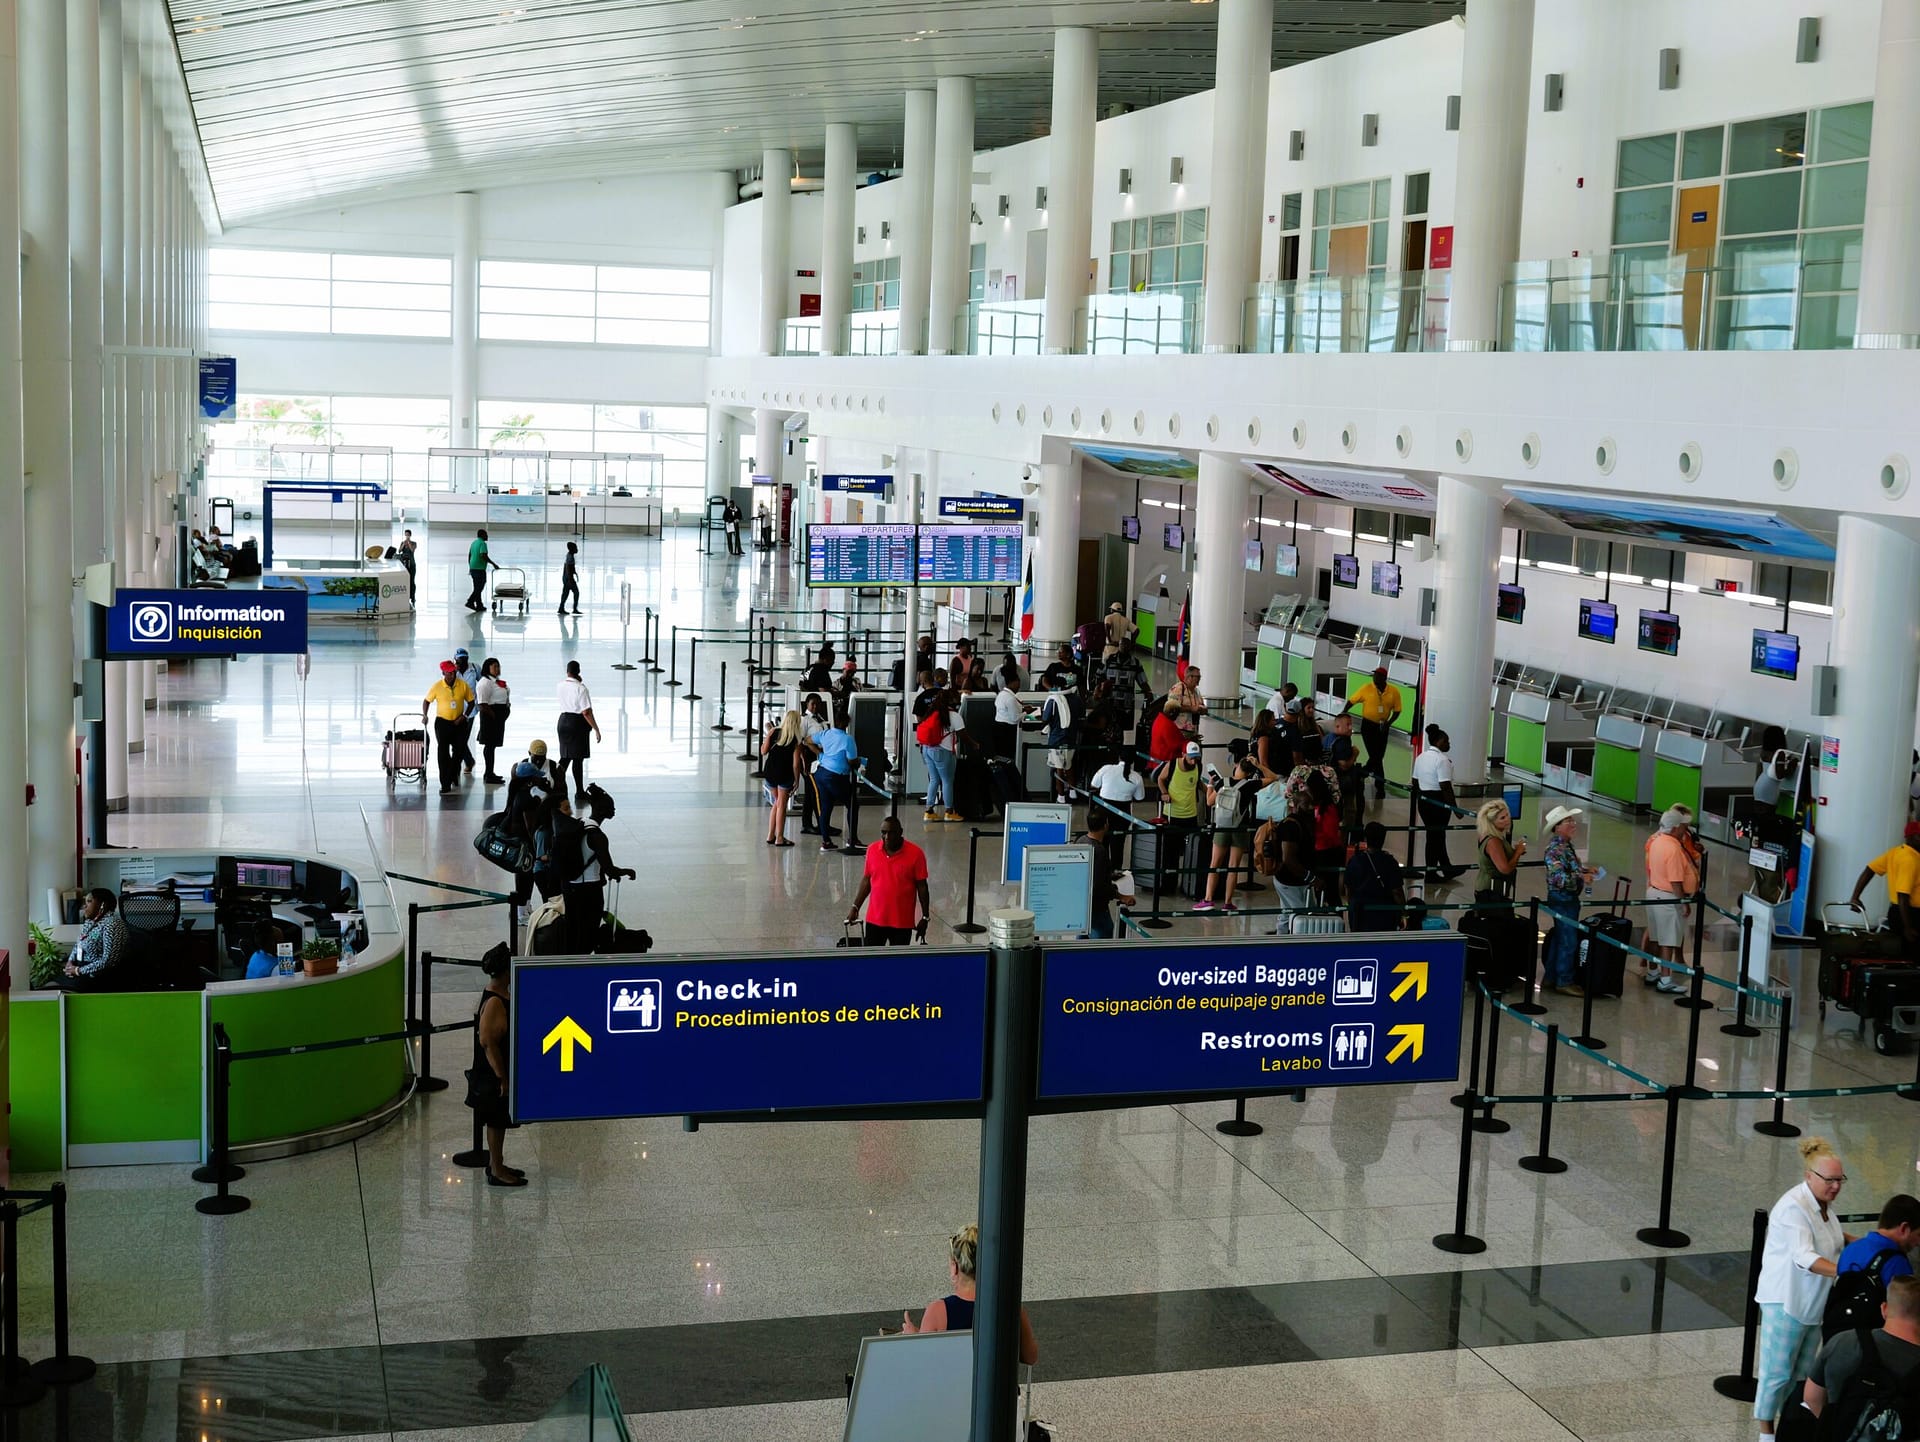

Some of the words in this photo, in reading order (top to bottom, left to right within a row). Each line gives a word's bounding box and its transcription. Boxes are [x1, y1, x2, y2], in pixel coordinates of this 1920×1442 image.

[861, 526, 914, 534] DEPARTURES
[983, 526, 1021, 534] ARRIVALS
[178, 604, 285, 622] Information
[1581, 613, 1590, 625] 17
[178, 625, 262, 642] Inquisición
[1640, 623, 1650, 637] 16
[1755, 645, 1766, 659] 15
[1158, 966, 1248, 987] Over-sized
[1255, 965, 1327, 986] Baggage
[676, 977, 798, 1001] Check-in
[1062, 995, 1173, 1016] Consignación
[1176, 994, 1197, 1010] de
[1199, 992, 1268, 1012] equipaje
[1271, 991, 1326, 1010] grande
[676, 1008, 830, 1028] Procedimientos
[835, 1005, 859, 1023] de
[864, 1004, 921, 1022] check
[925, 1002, 942, 1019] in
[1200, 1029, 1324, 1051] Restrooms
[1261, 1055, 1322, 1072] Lavabo
